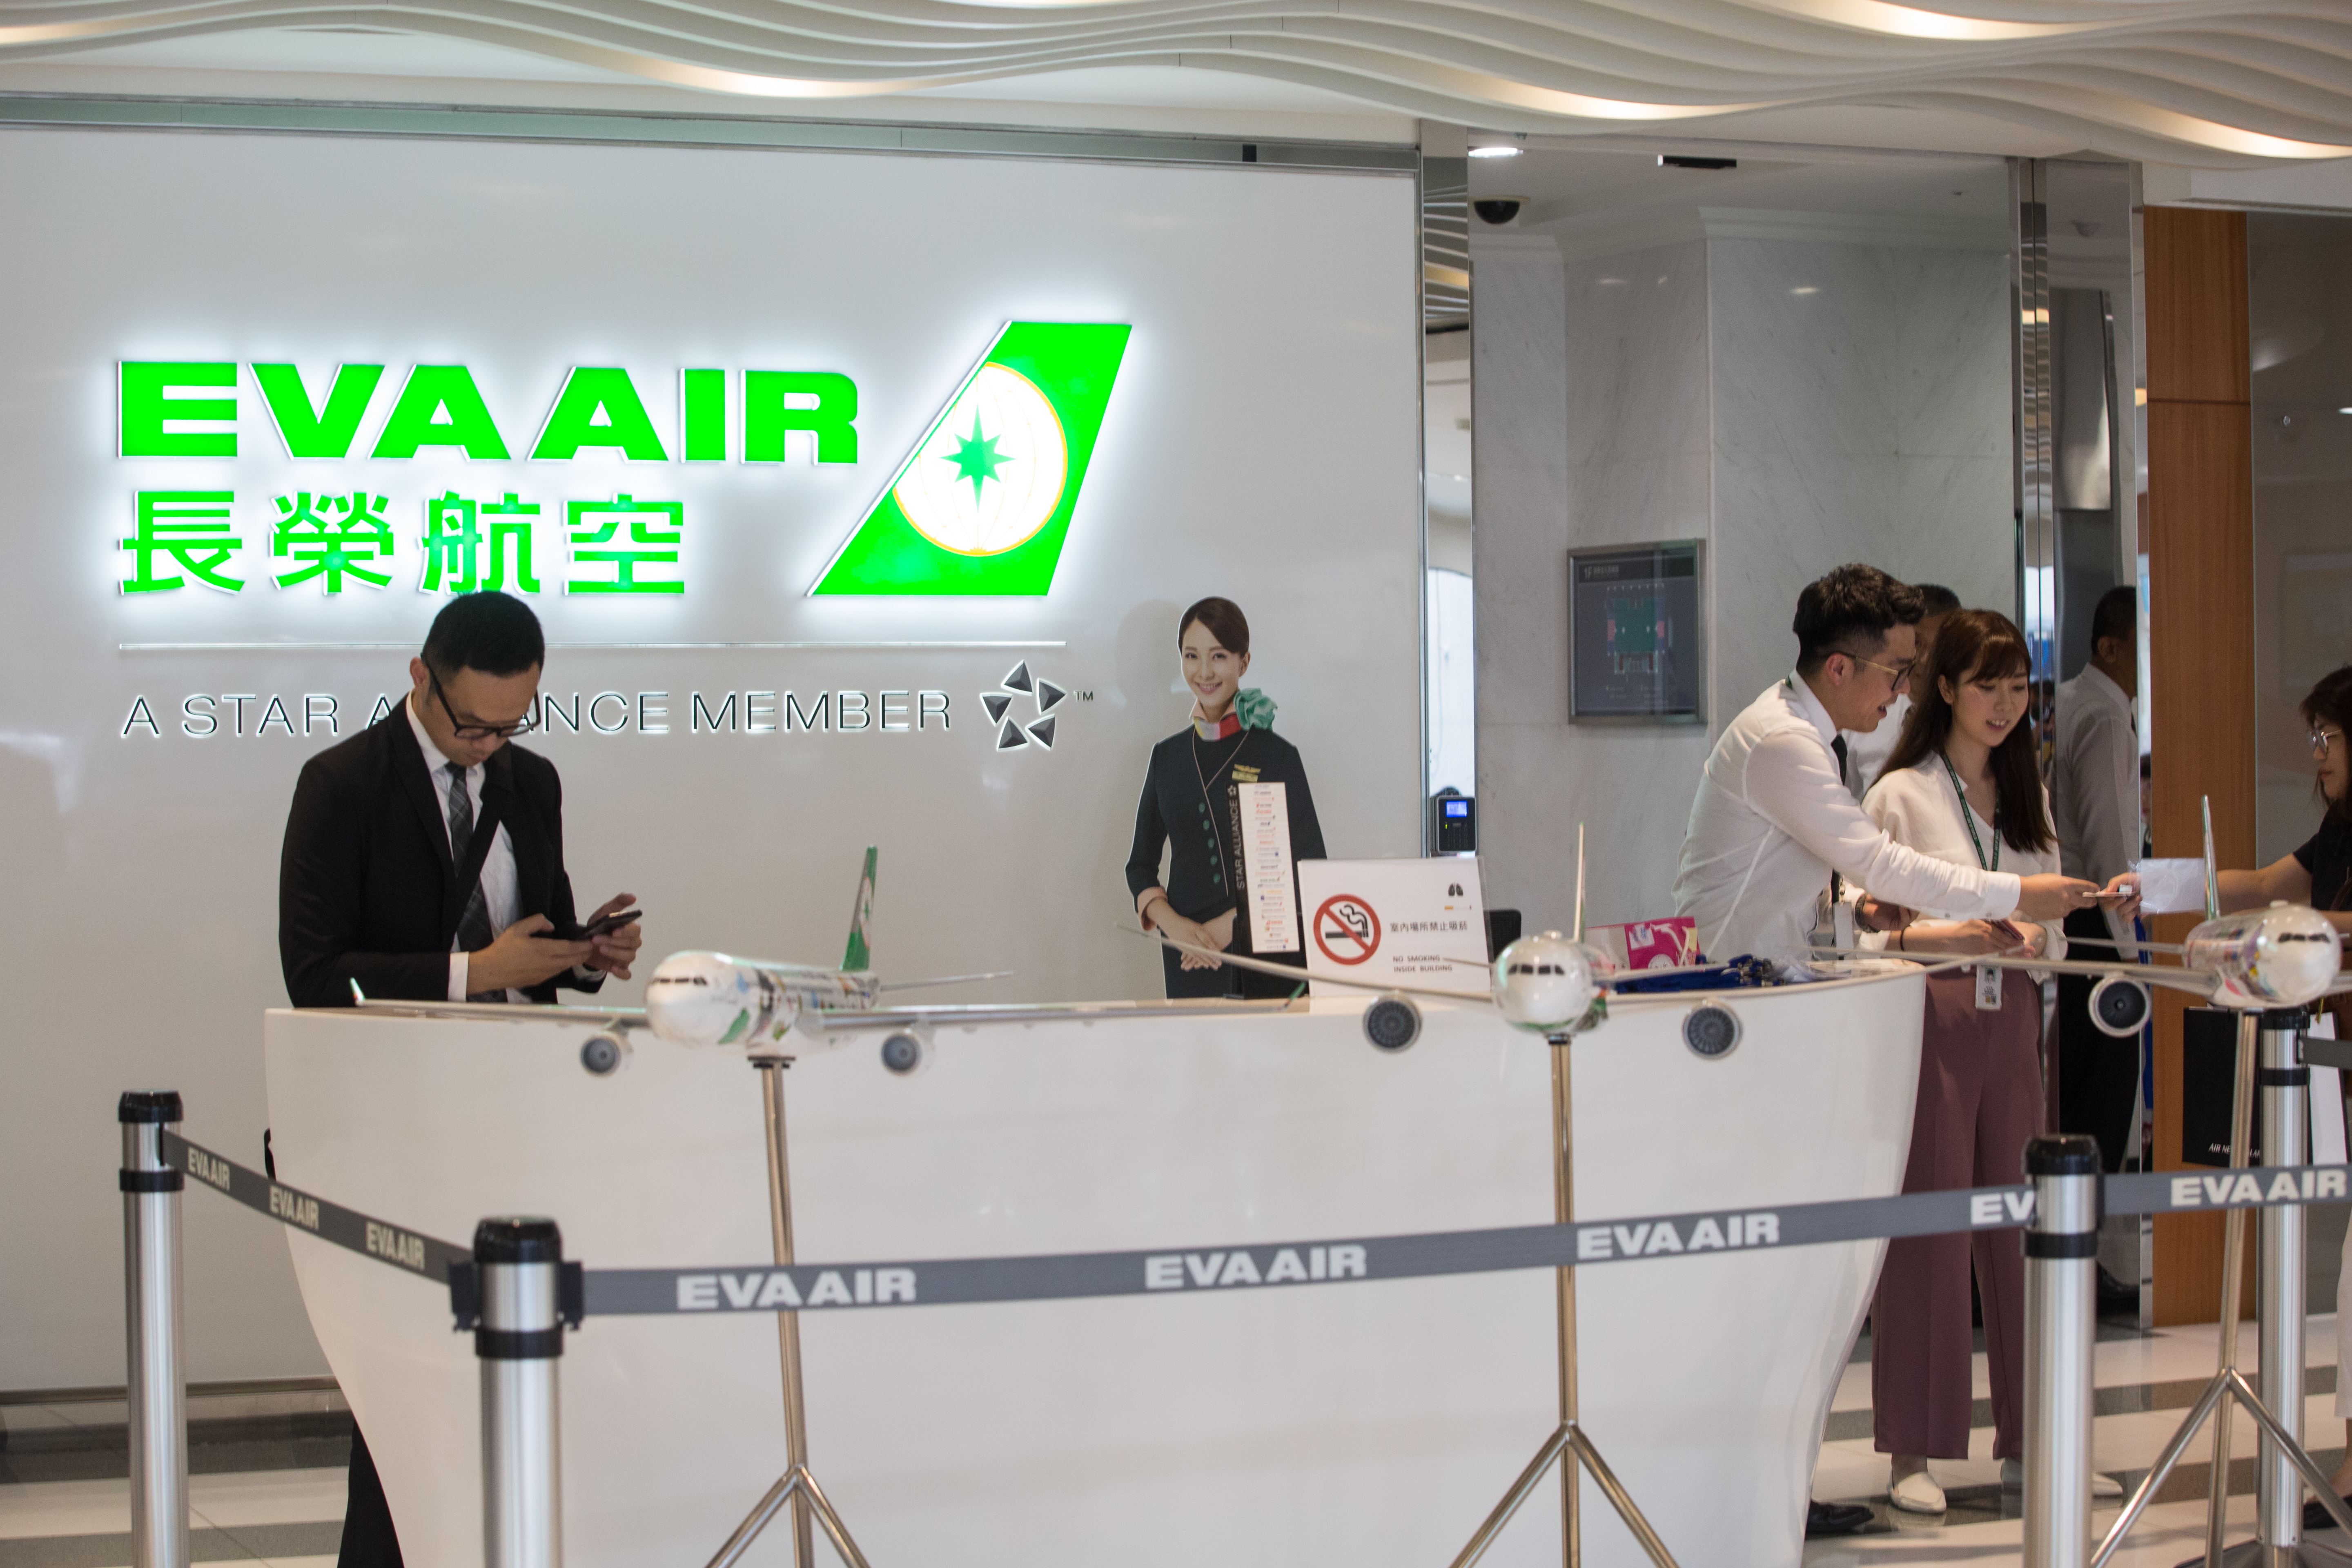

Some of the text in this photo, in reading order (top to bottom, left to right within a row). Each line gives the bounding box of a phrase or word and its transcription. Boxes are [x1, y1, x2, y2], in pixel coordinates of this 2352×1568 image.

[119, 490, 685, 596] 長榮航空
[121, 694, 160, 738] A
[181, 693, 339, 738] STAR
[691, 690, 951, 734] MEMBER
[1229, 799, 1245, 890] STAR ALLIANCE
[2208, 1143, 2221, 1154] AIR
[1970, 1190, 2035, 1225] EV
